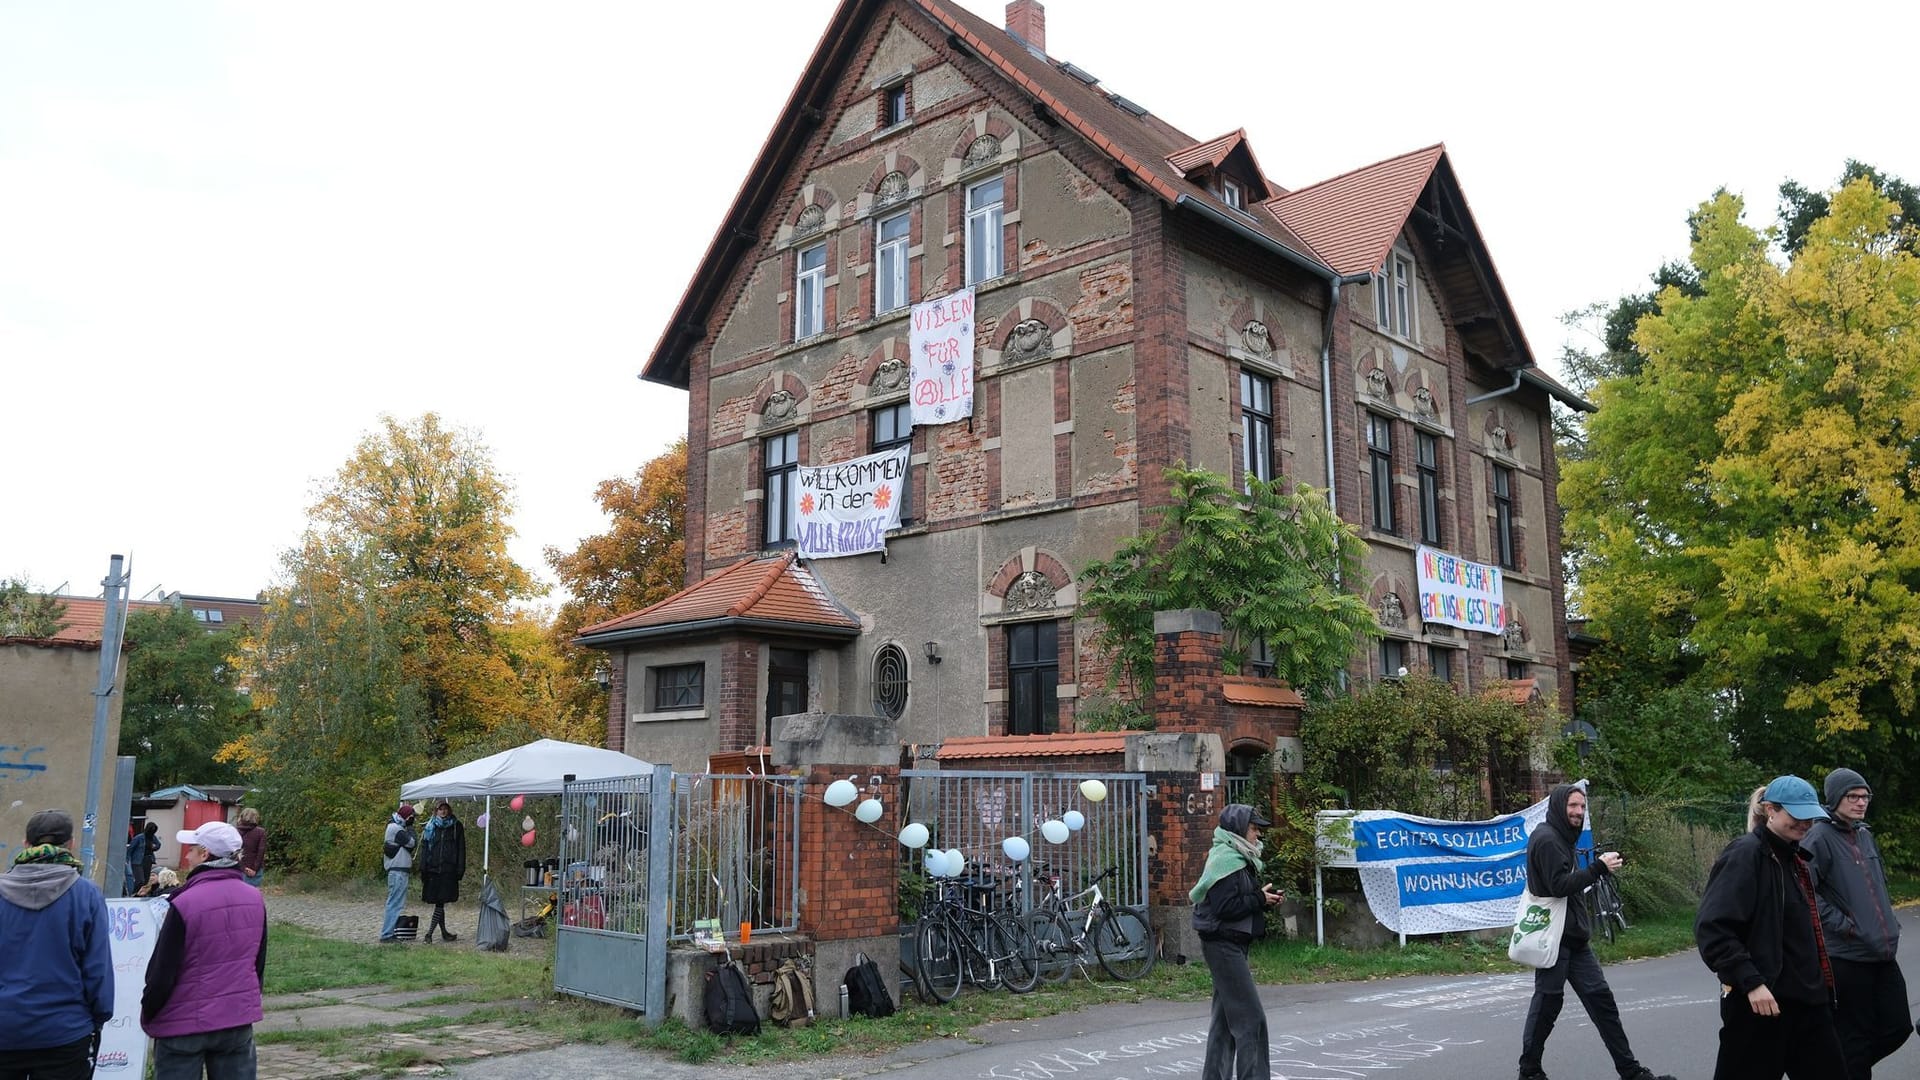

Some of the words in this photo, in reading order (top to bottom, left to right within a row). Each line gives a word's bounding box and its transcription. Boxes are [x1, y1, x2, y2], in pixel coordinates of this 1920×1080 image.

[927, 337, 960, 368] FÜR
[799, 456, 906, 491] WILLKOMMEN
[818, 492, 834, 512] in
[841, 488, 873, 509] der
[797, 521, 835, 554] VILLA
[838, 515, 886, 553] KRAUSE
[1423, 551, 1497, 595] NACHBARSCHAFT
[1187, 793, 1213, 815] 6-8
[1376, 829, 1440, 849] ECHTER
[1442, 826, 1524, 848] SOZIALER
